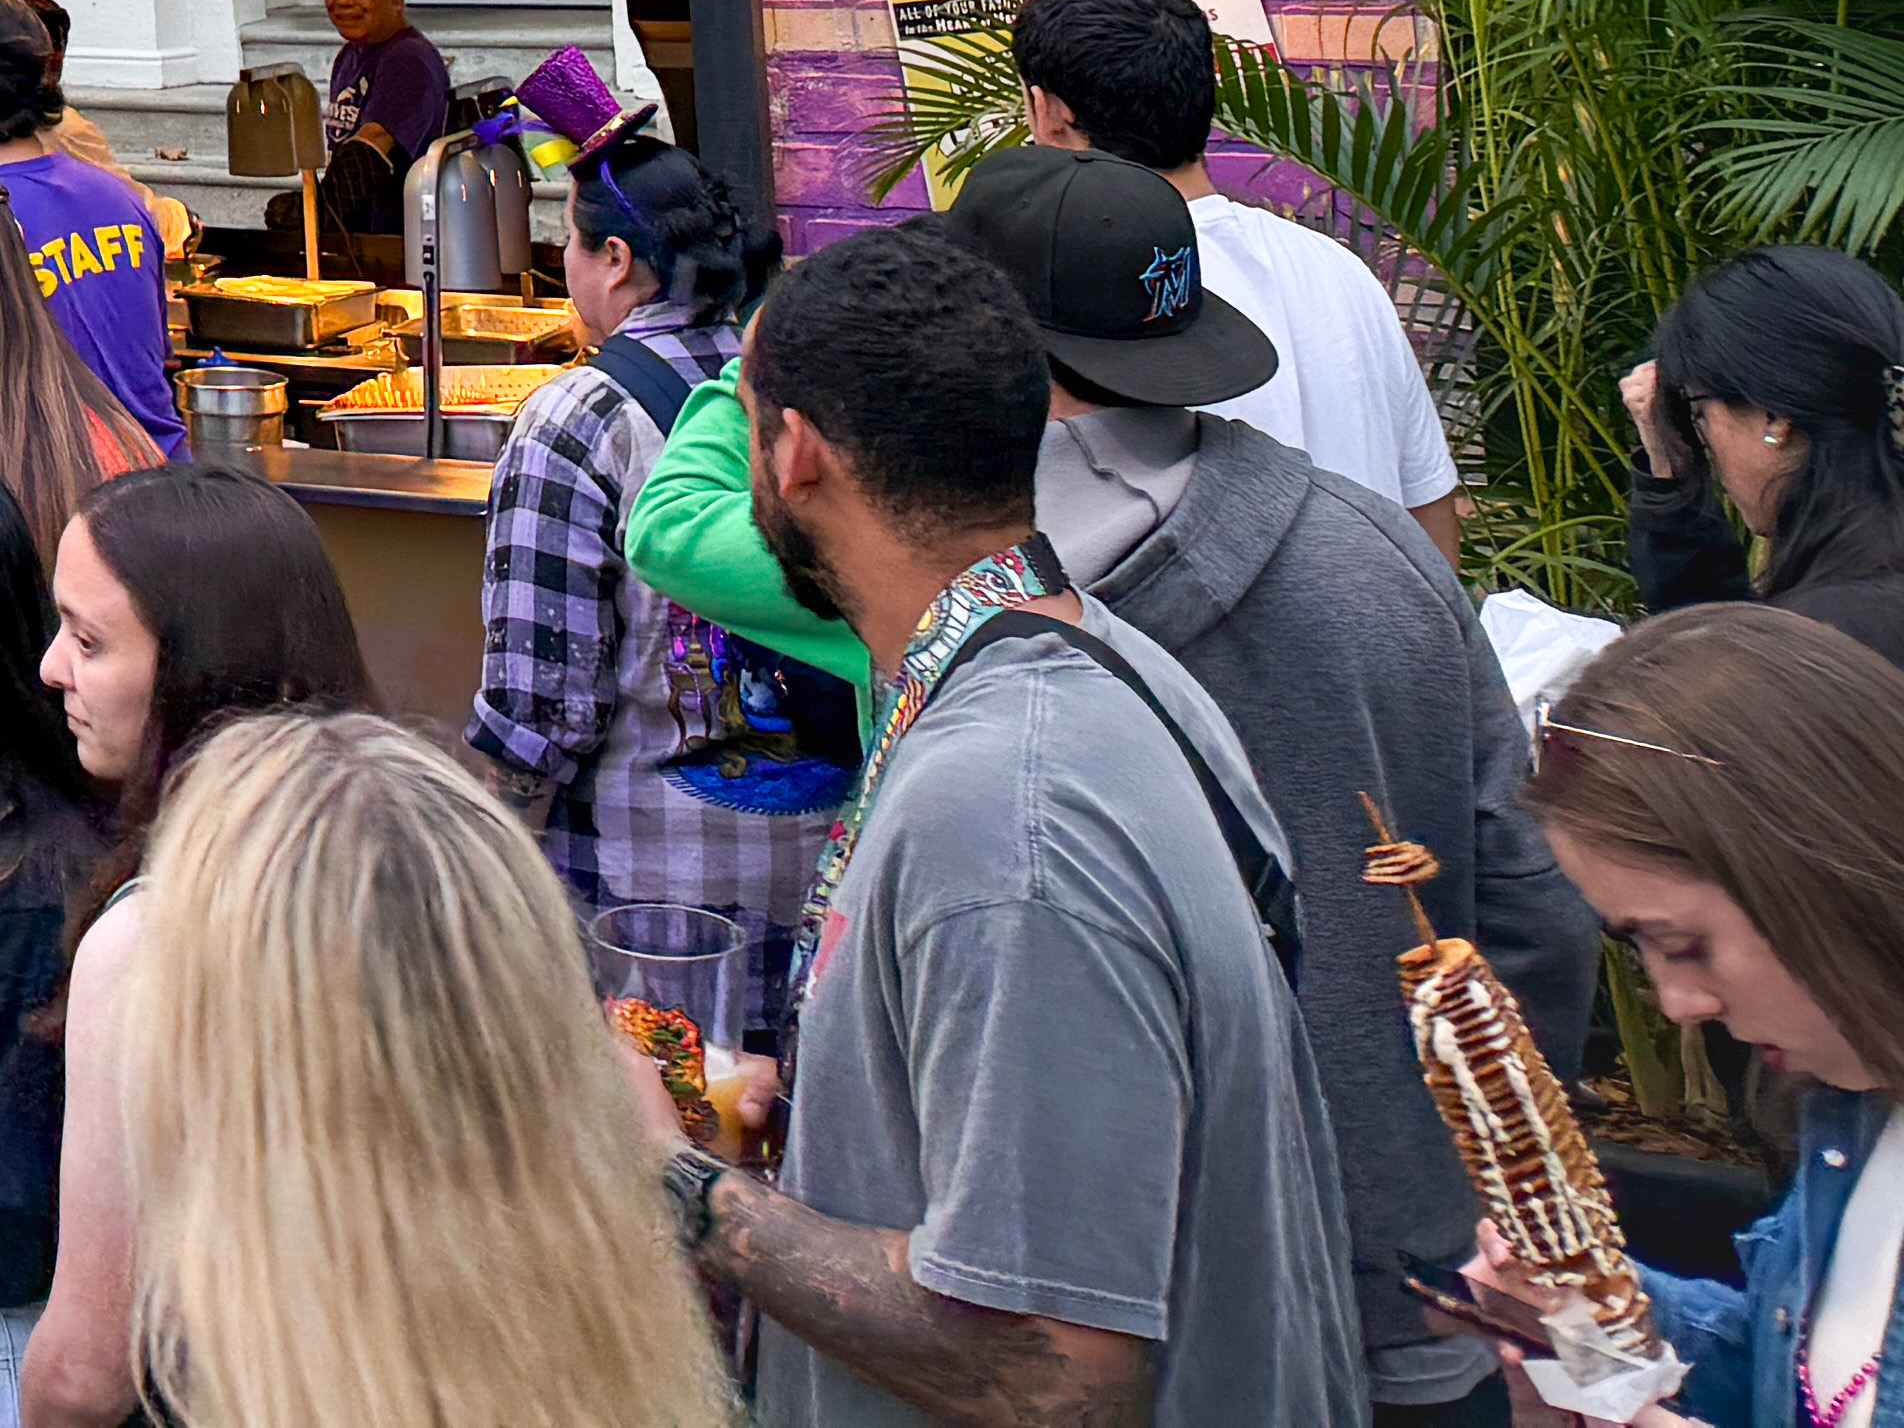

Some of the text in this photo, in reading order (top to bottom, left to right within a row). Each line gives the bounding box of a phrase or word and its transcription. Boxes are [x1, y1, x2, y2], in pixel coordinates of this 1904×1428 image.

[899, 6, 922, 22] ALL
[924, 3, 940, 19] OF
[943, 0, 976, 16] YOUR
[29, 224, 145, 298] STAFF
